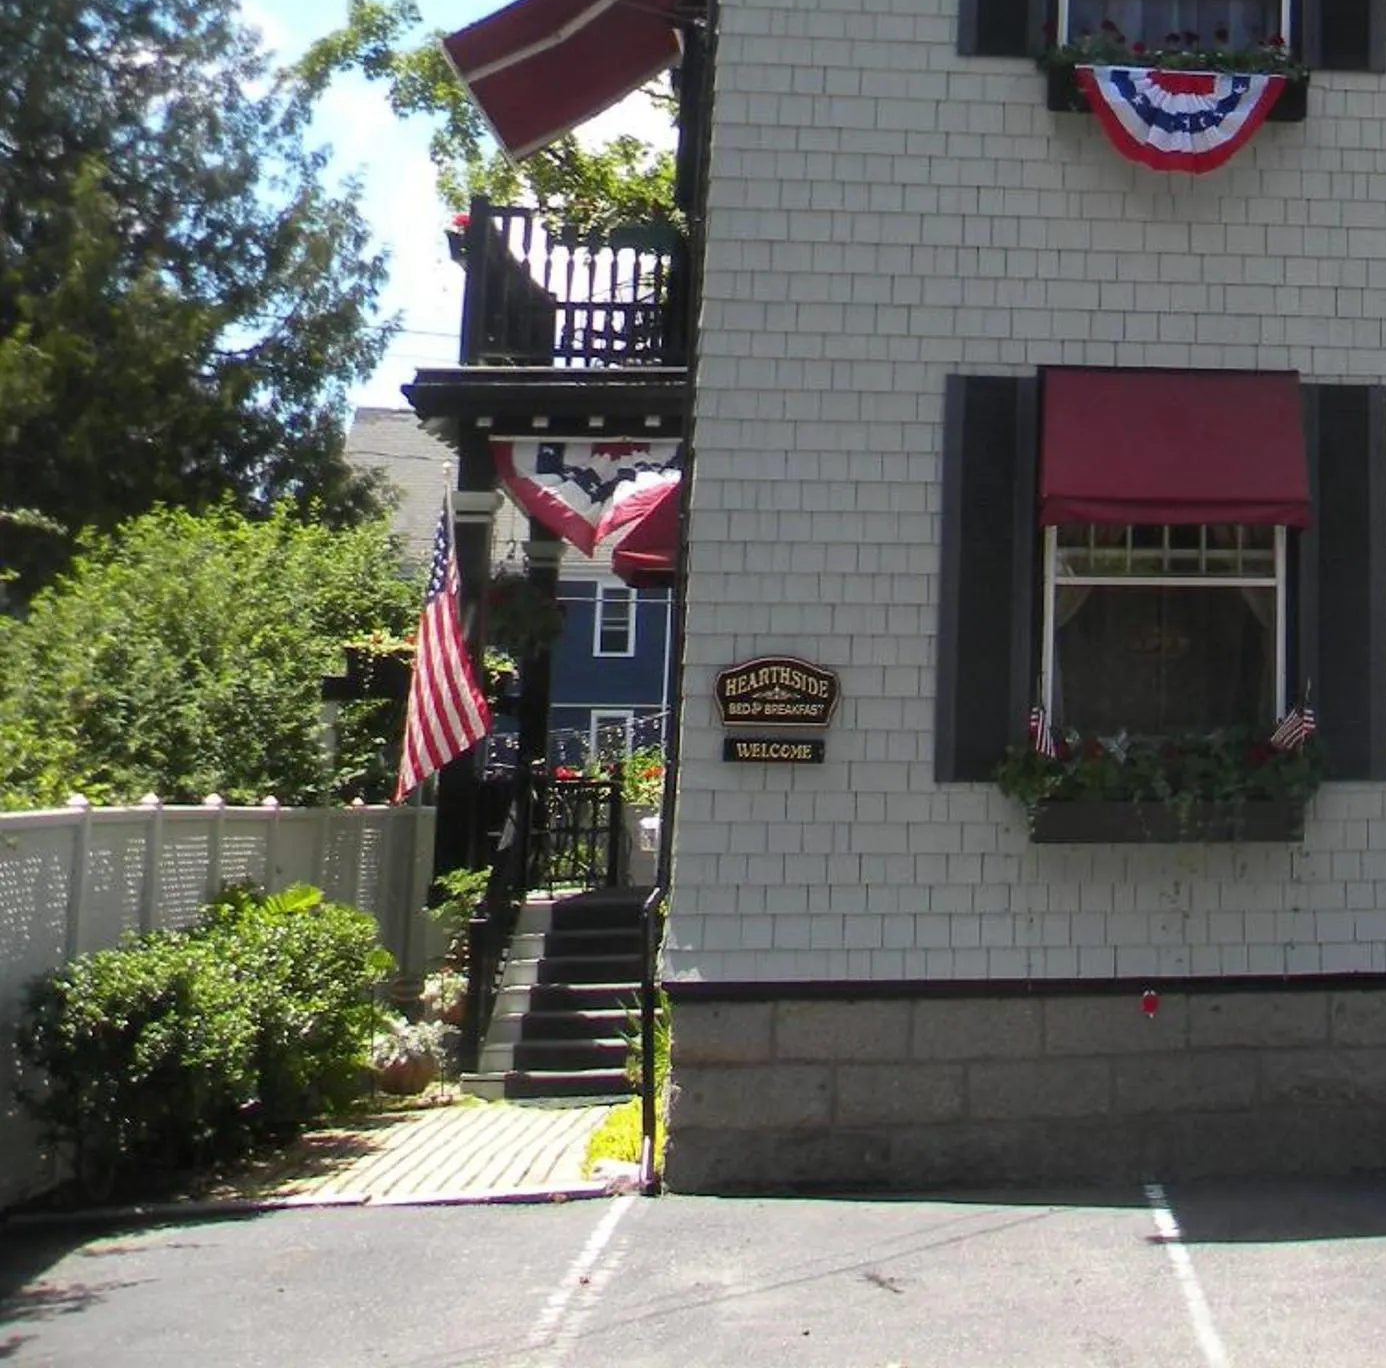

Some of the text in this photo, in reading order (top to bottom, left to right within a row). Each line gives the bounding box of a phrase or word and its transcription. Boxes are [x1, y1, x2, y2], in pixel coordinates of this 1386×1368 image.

[725, 666, 829, 698] HEARTHSIDE
[729, 703, 751, 715] BED
[764, 704, 825, 716] BREAKFAST
[736, 743, 812, 759] WELCOME
